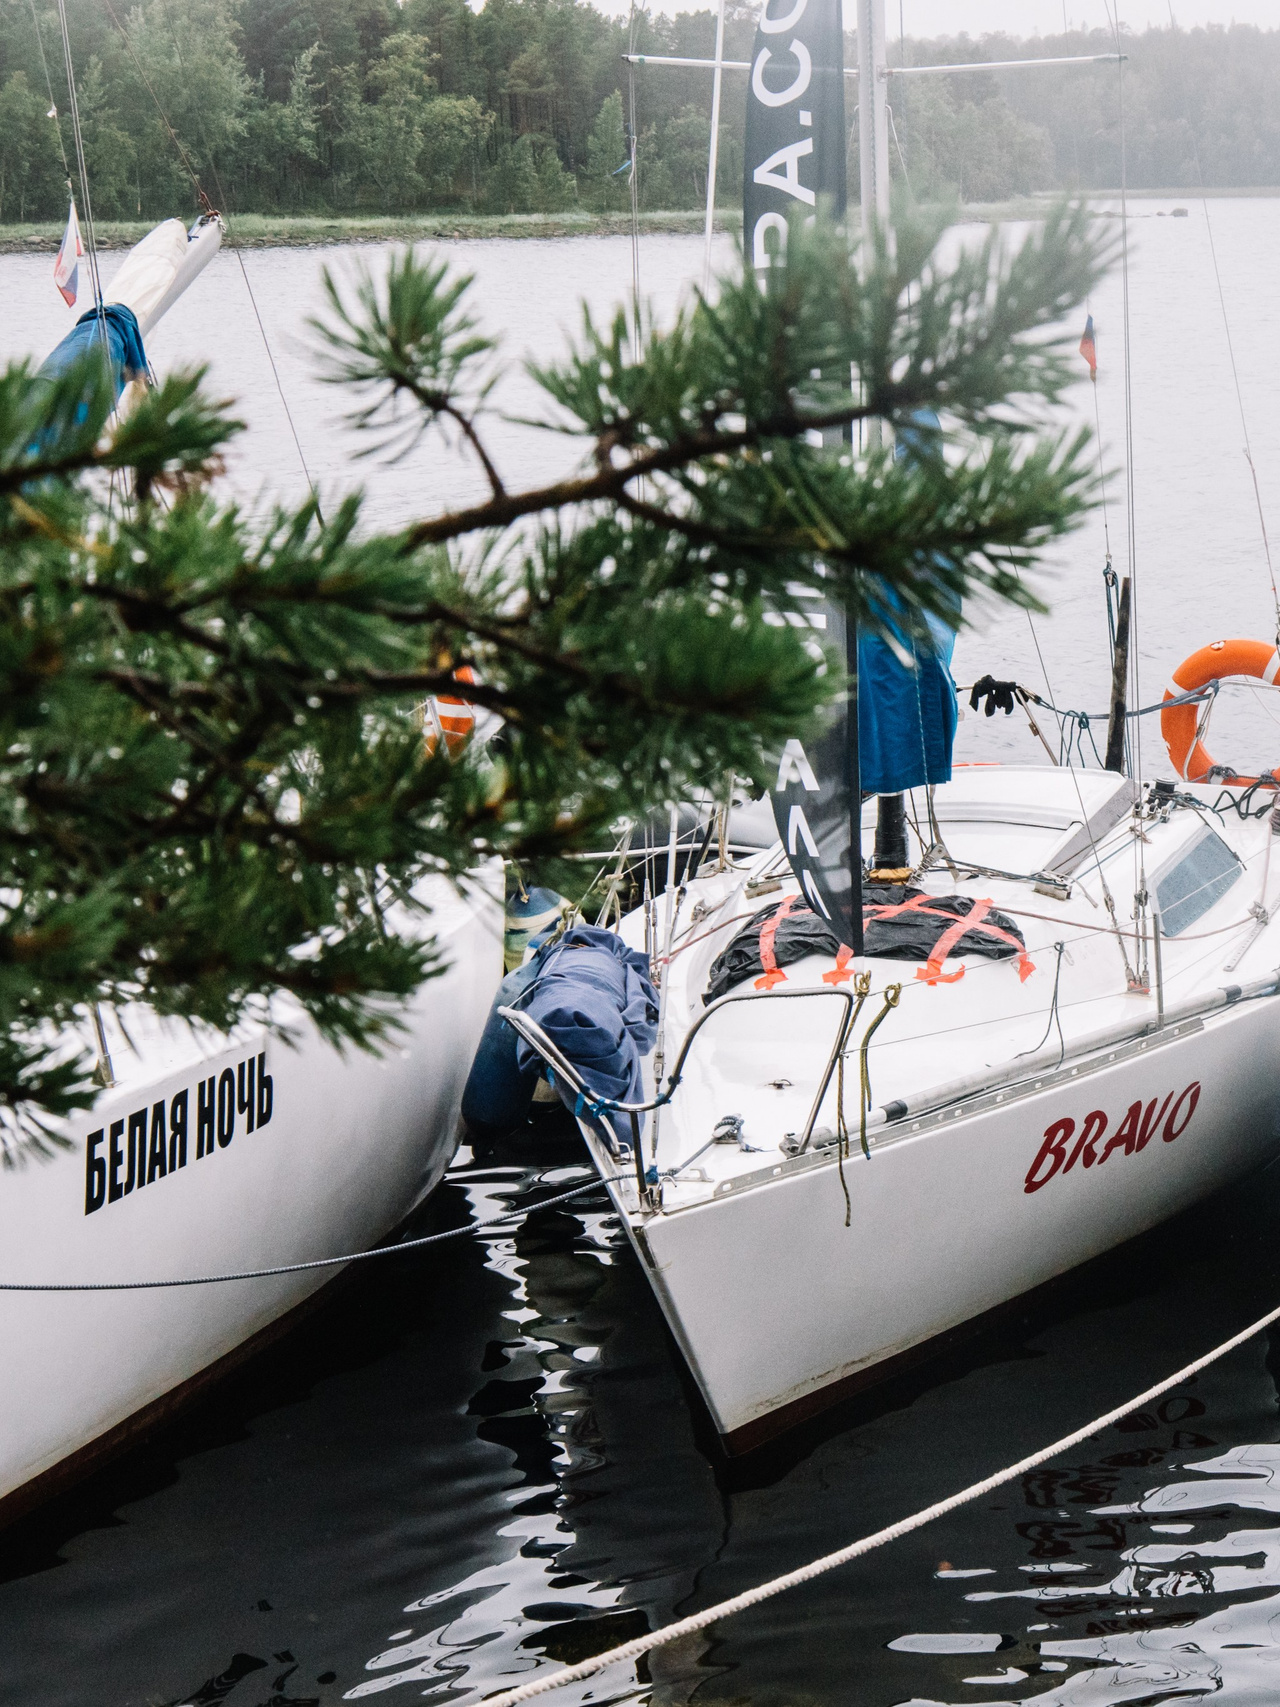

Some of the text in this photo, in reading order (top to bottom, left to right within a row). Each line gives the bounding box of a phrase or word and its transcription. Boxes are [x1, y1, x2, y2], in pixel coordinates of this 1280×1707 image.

[85, 1051, 273, 1216] БЕЛАЯ НОЧЬ
[1024, 1081, 1201, 1194] BRAVO
